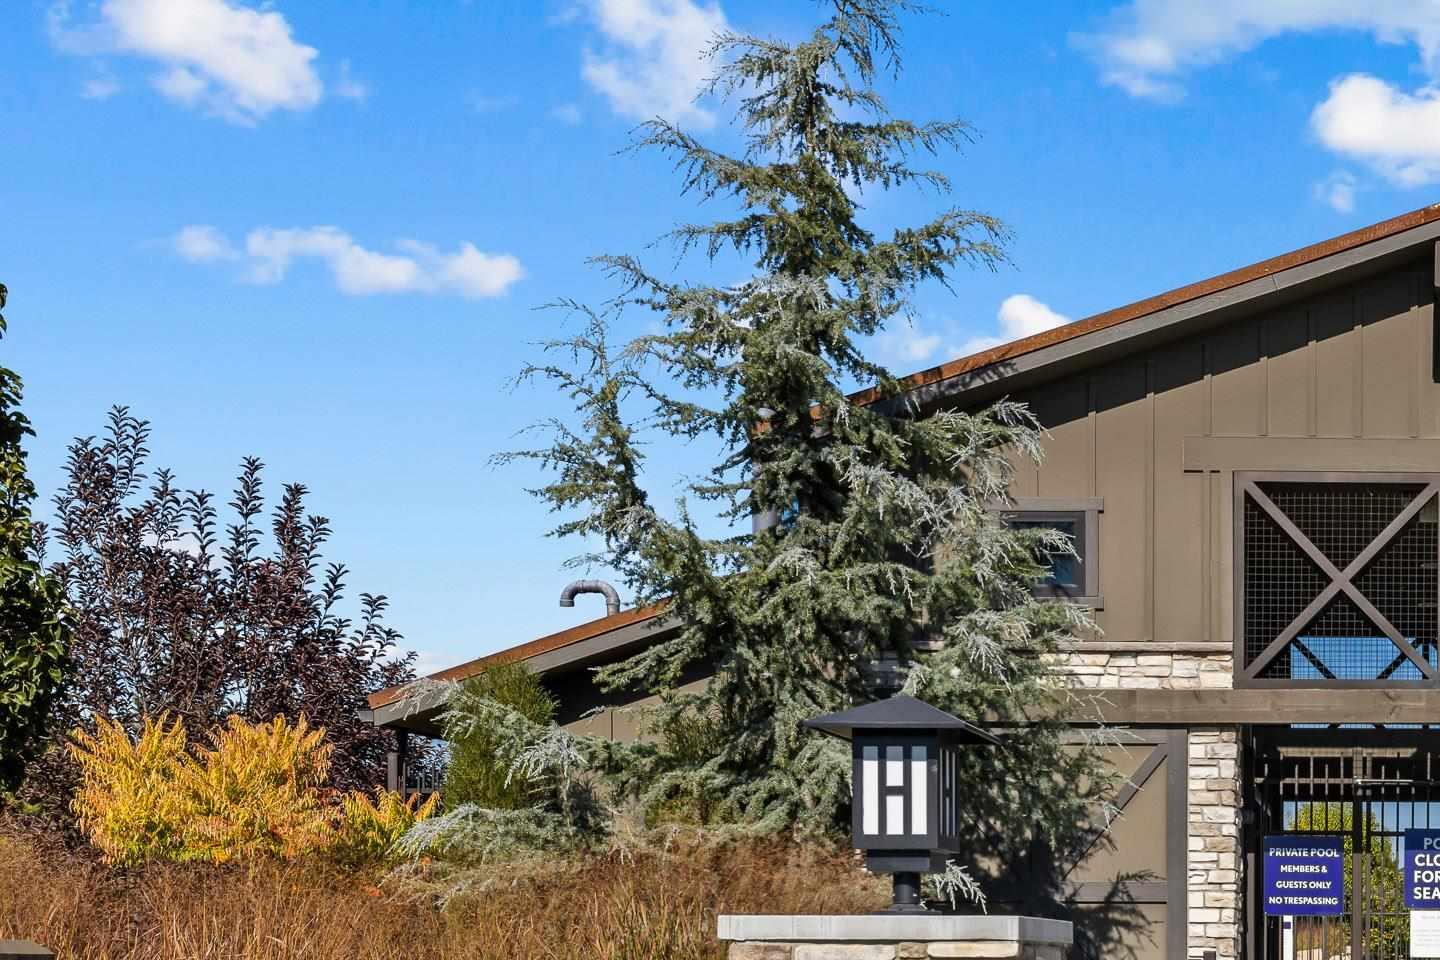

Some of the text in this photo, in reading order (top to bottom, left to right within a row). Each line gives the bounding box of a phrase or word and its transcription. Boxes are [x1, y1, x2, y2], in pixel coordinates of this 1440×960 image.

[1269, 847, 1340, 857] PRIVATE POOL
[1280, 865, 1328, 873] MEMBERS &
[1275, 881, 1332, 889] GUESTS ONLY
[1268, 896, 1338, 905] NO TRESPASSING
